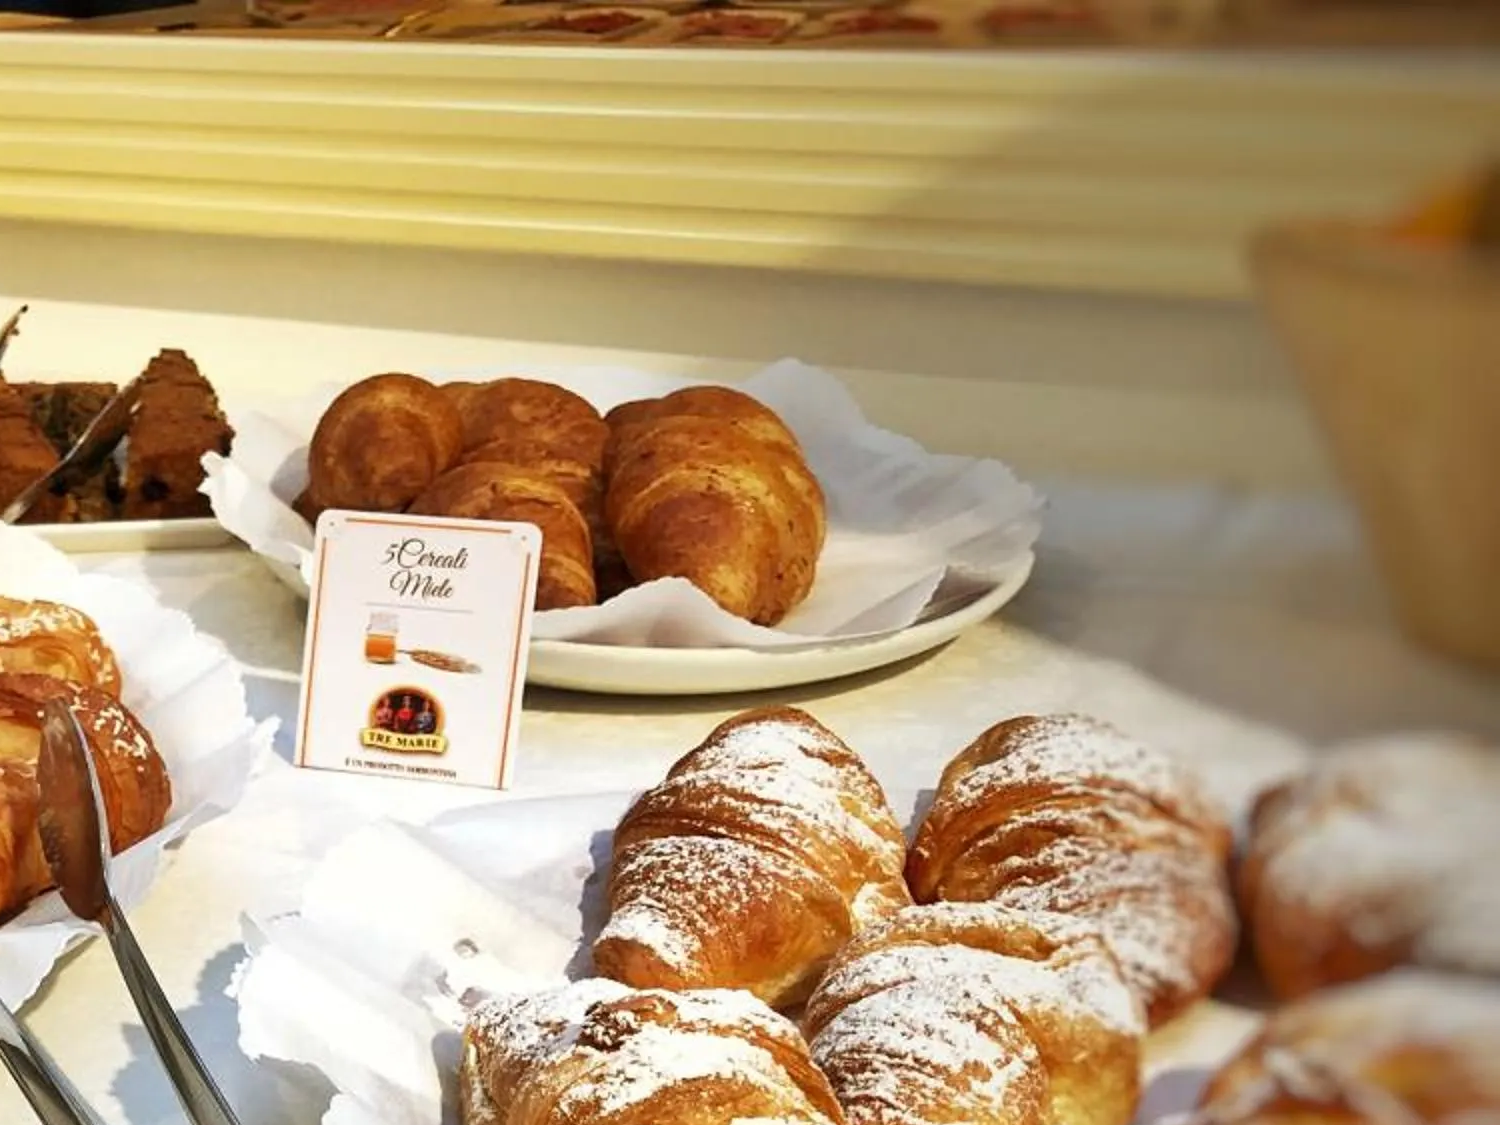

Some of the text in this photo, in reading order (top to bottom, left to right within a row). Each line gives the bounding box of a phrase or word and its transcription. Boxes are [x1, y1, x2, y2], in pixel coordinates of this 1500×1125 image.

[397, 538, 468, 569] Cereali
[389, 569, 453, 598] Miele
[368, 732, 438, 749] TRE MARIE
